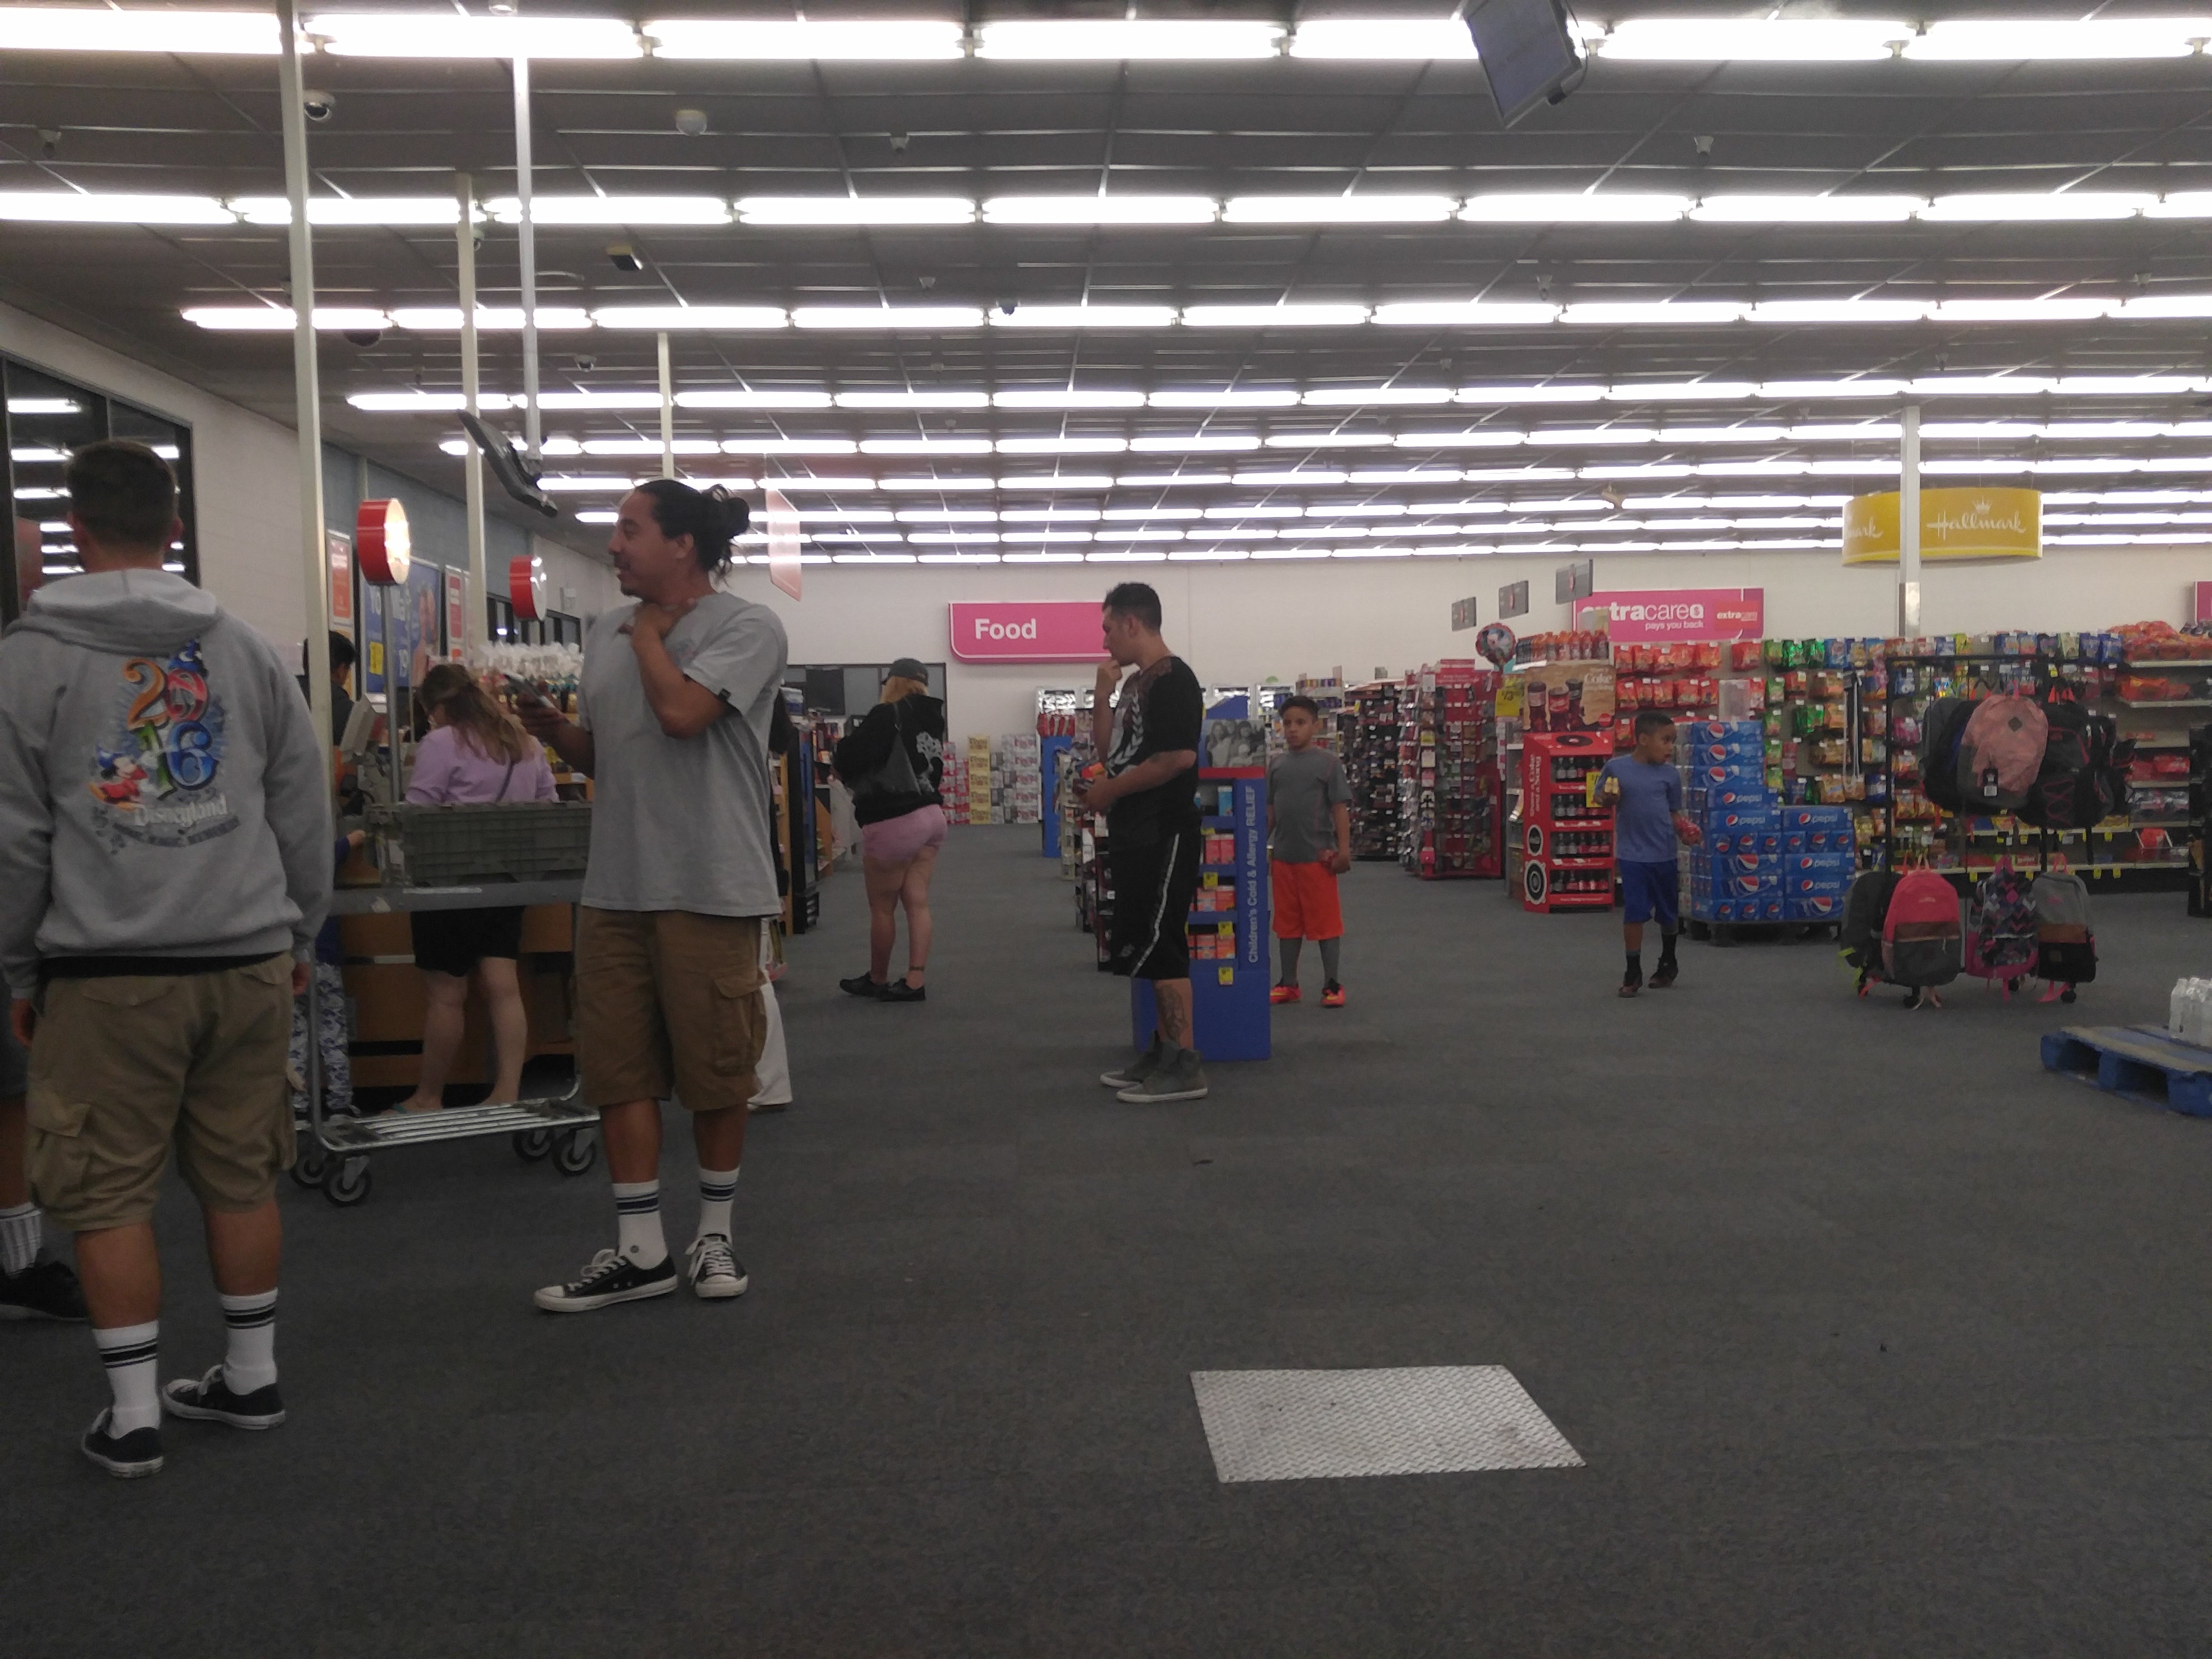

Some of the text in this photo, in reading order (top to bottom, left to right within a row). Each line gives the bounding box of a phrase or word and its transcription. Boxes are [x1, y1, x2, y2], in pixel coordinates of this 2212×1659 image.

[1926, 509, 2026, 541] Hallmark
[1582, 601, 1690, 621] tracare
[974, 617, 1037, 640] Food
[1645, 620, 1704, 631] pays you back
[1736, 793, 1762, 803] pepsi
[1739, 816, 1766, 826] pepsi
[1811, 813, 1838, 824] pepsi
[1247, 829, 1258, 867] Allergy
[1814, 858, 1840, 867] pepsi
[1813, 880, 1840, 890] pepsi
[1247, 880, 1258, 907] Cold
[1248, 908, 1258, 963] Children's
